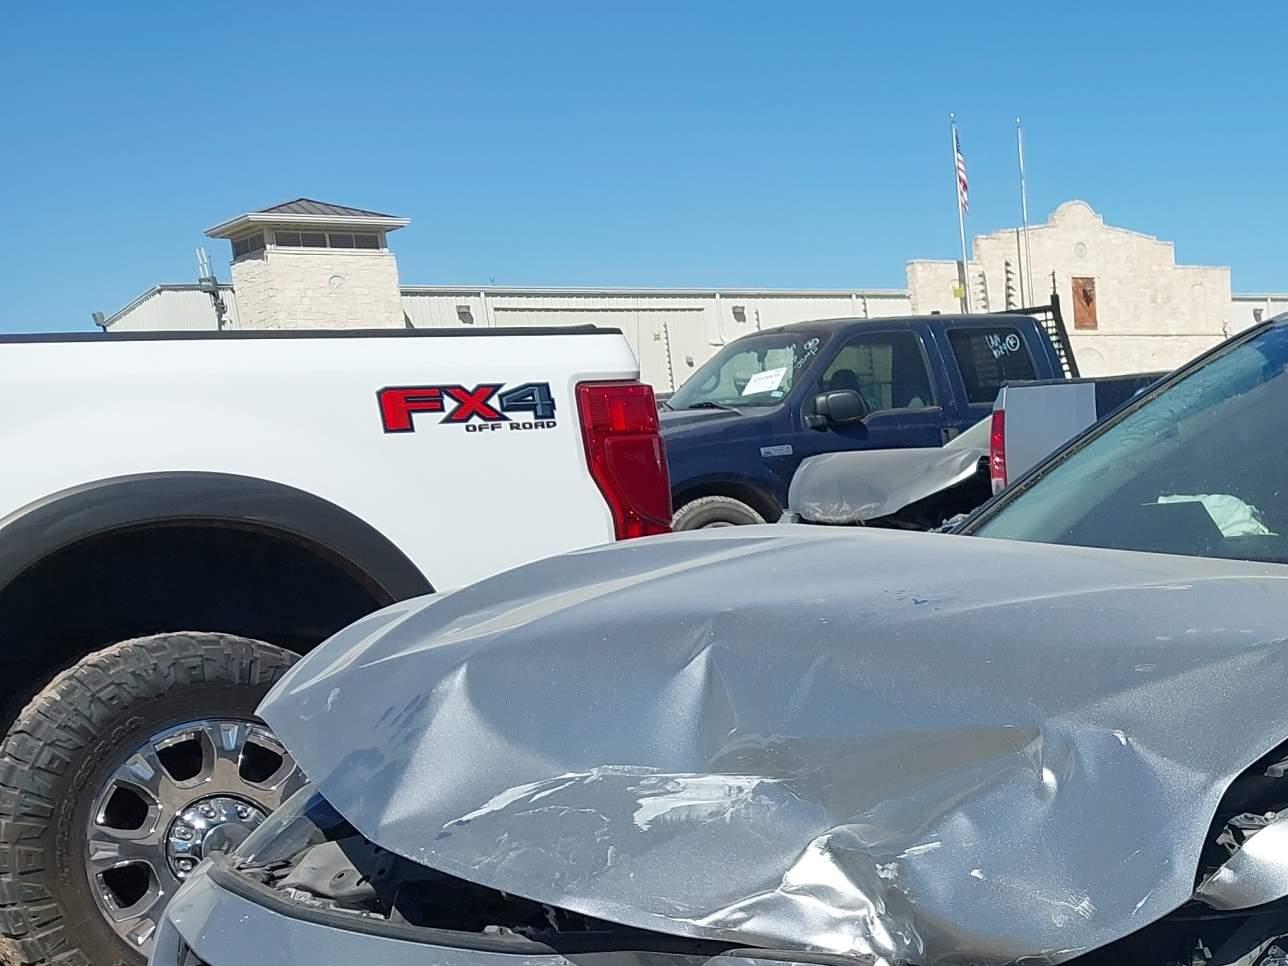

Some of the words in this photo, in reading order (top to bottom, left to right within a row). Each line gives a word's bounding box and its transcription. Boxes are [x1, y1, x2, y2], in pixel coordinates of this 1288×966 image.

[375, 381, 556, 434] FX4
[466, 423, 503, 432] OFF
[510, 420, 557, 431] ROAD
